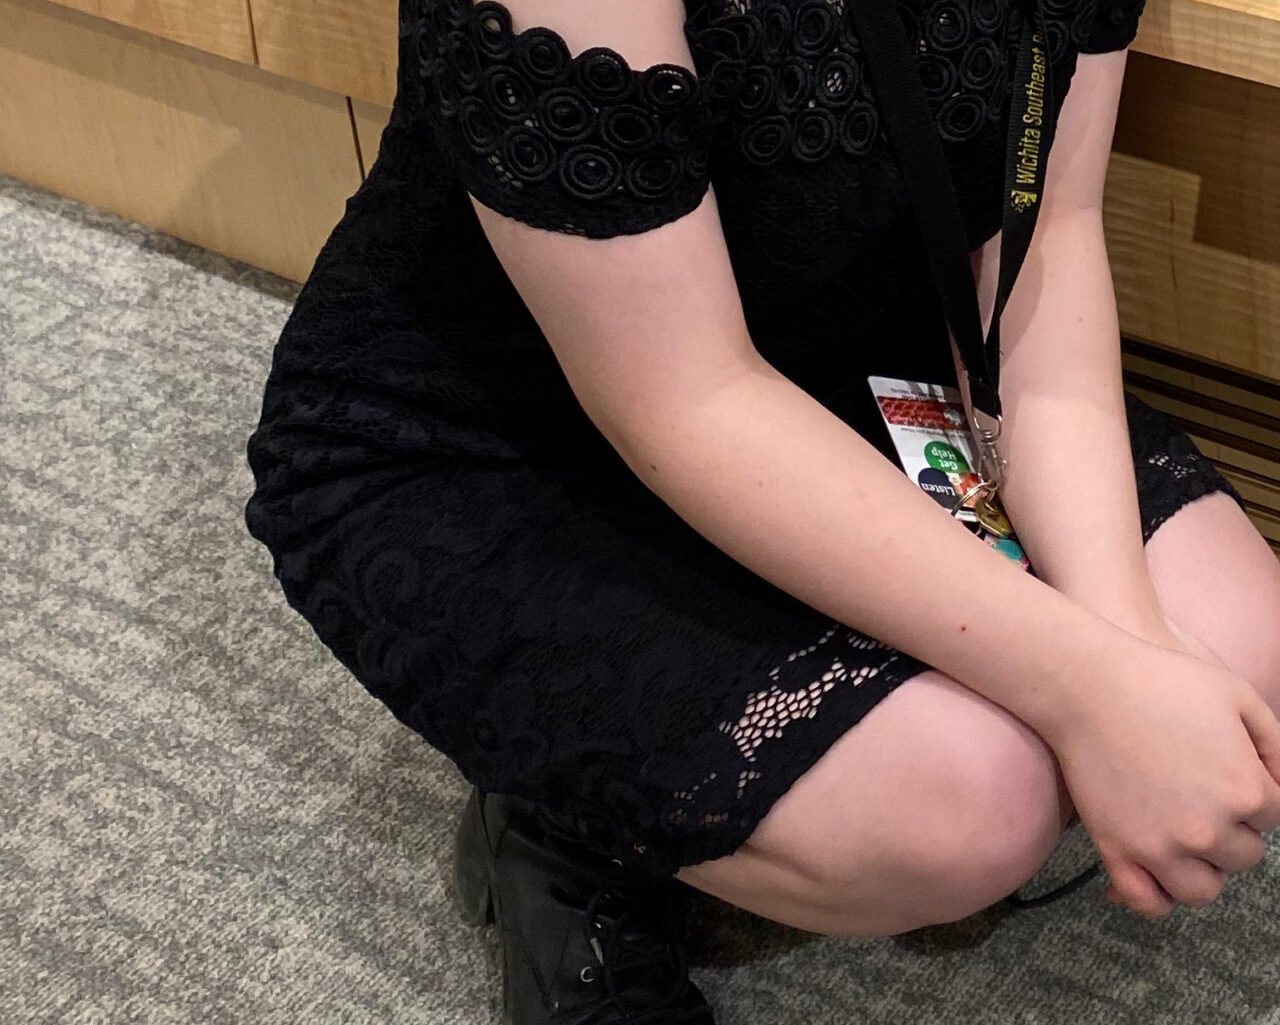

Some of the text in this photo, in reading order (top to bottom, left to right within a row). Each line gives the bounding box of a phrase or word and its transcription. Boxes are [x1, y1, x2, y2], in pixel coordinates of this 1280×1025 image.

[1022, 46, 1046, 126] Southeast
[1015, 128, 1041, 185] Wichita
[931, 447, 957, 460] Help
[938, 459, 958, 470] Get
[920, 483, 956, 496] Listen
